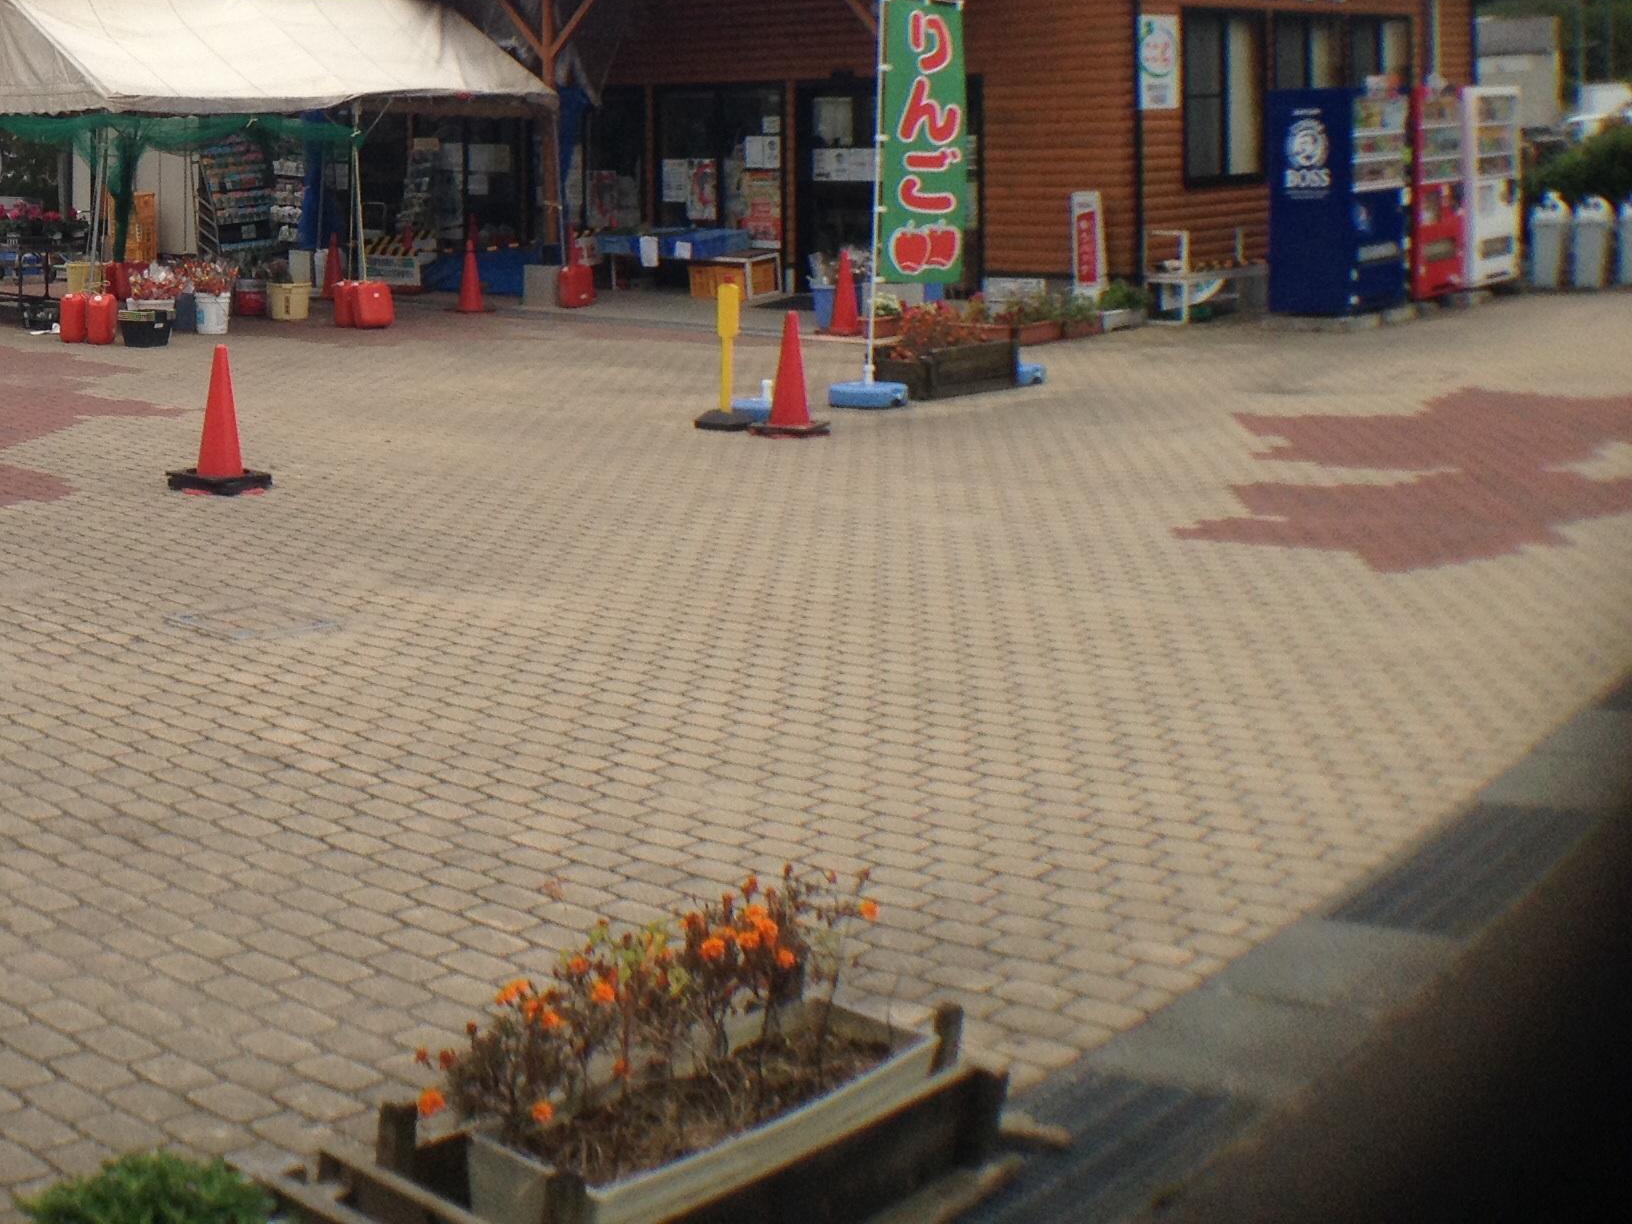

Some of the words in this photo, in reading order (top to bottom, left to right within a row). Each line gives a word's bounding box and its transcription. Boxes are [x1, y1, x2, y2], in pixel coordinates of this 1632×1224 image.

[897, 9, 962, 215] りんご
[1285, 167, 1331, 188] BOSS
